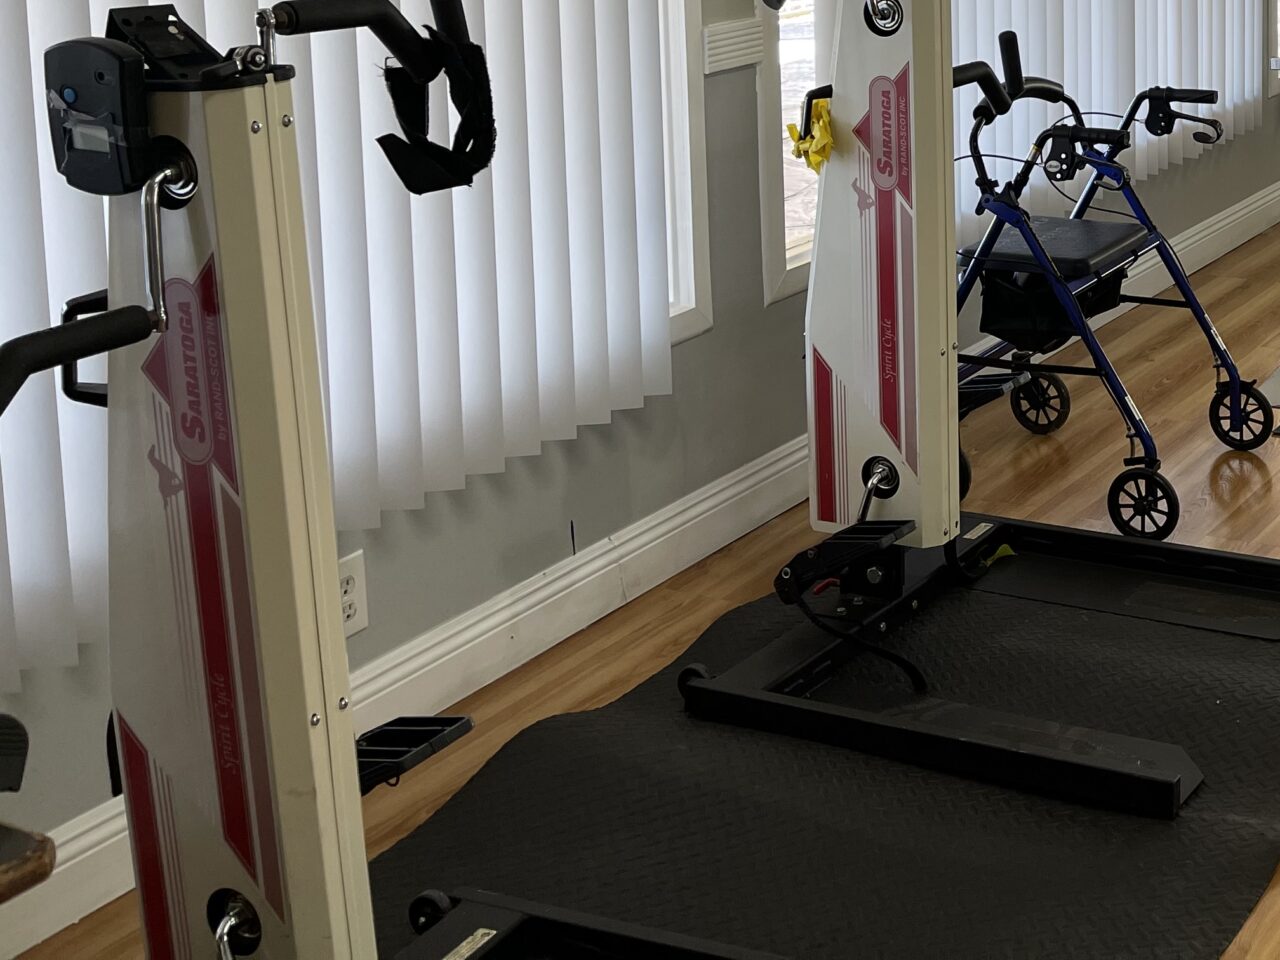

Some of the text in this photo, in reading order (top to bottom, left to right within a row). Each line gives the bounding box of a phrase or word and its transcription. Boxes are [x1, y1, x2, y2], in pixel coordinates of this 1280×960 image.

[877, 90, 893, 178] SARATOGA
[902, 166, 908, 176] by
[177, 302, 205, 443] SARATOGA
[881, 318, 897, 383] Spirit Cycle
[217, 425, 227, 440] by
